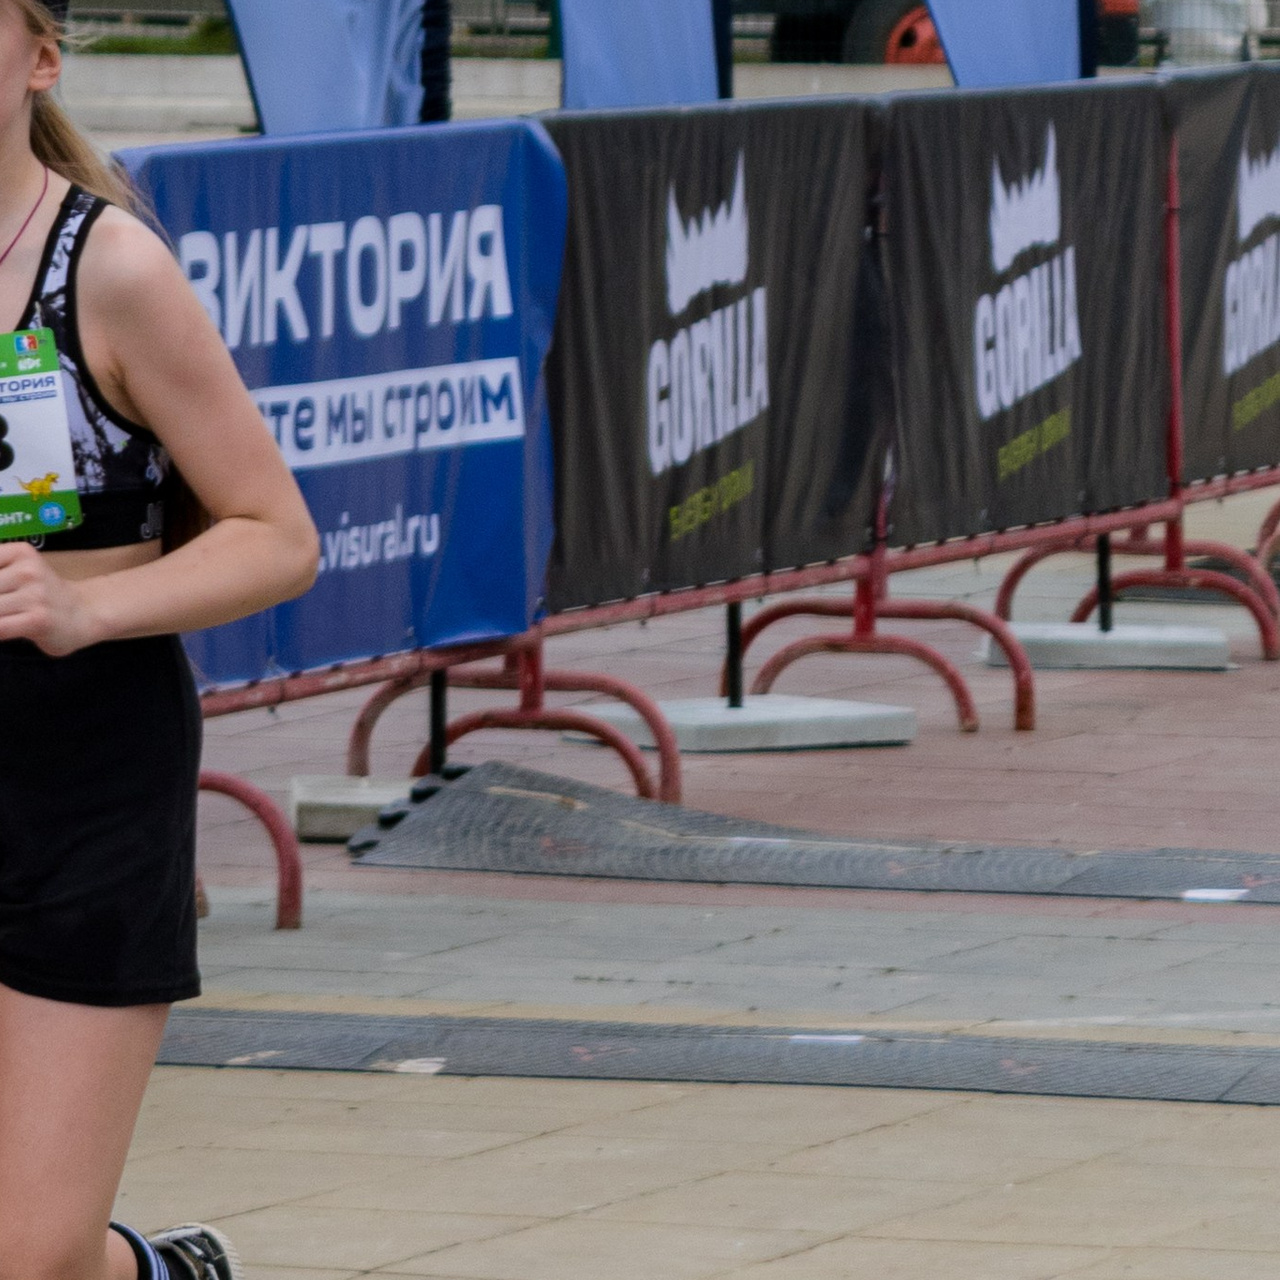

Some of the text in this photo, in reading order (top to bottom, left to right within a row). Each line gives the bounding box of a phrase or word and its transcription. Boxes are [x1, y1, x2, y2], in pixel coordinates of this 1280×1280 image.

[179, 204, 514, 350] ВИКТОРИЯ
[974, 245, 1082, 421] GORILLA
[326, 389, 374, 448] мы
[382, 372, 517, 451] строим
[647, 286, 770, 478] GORILLA
